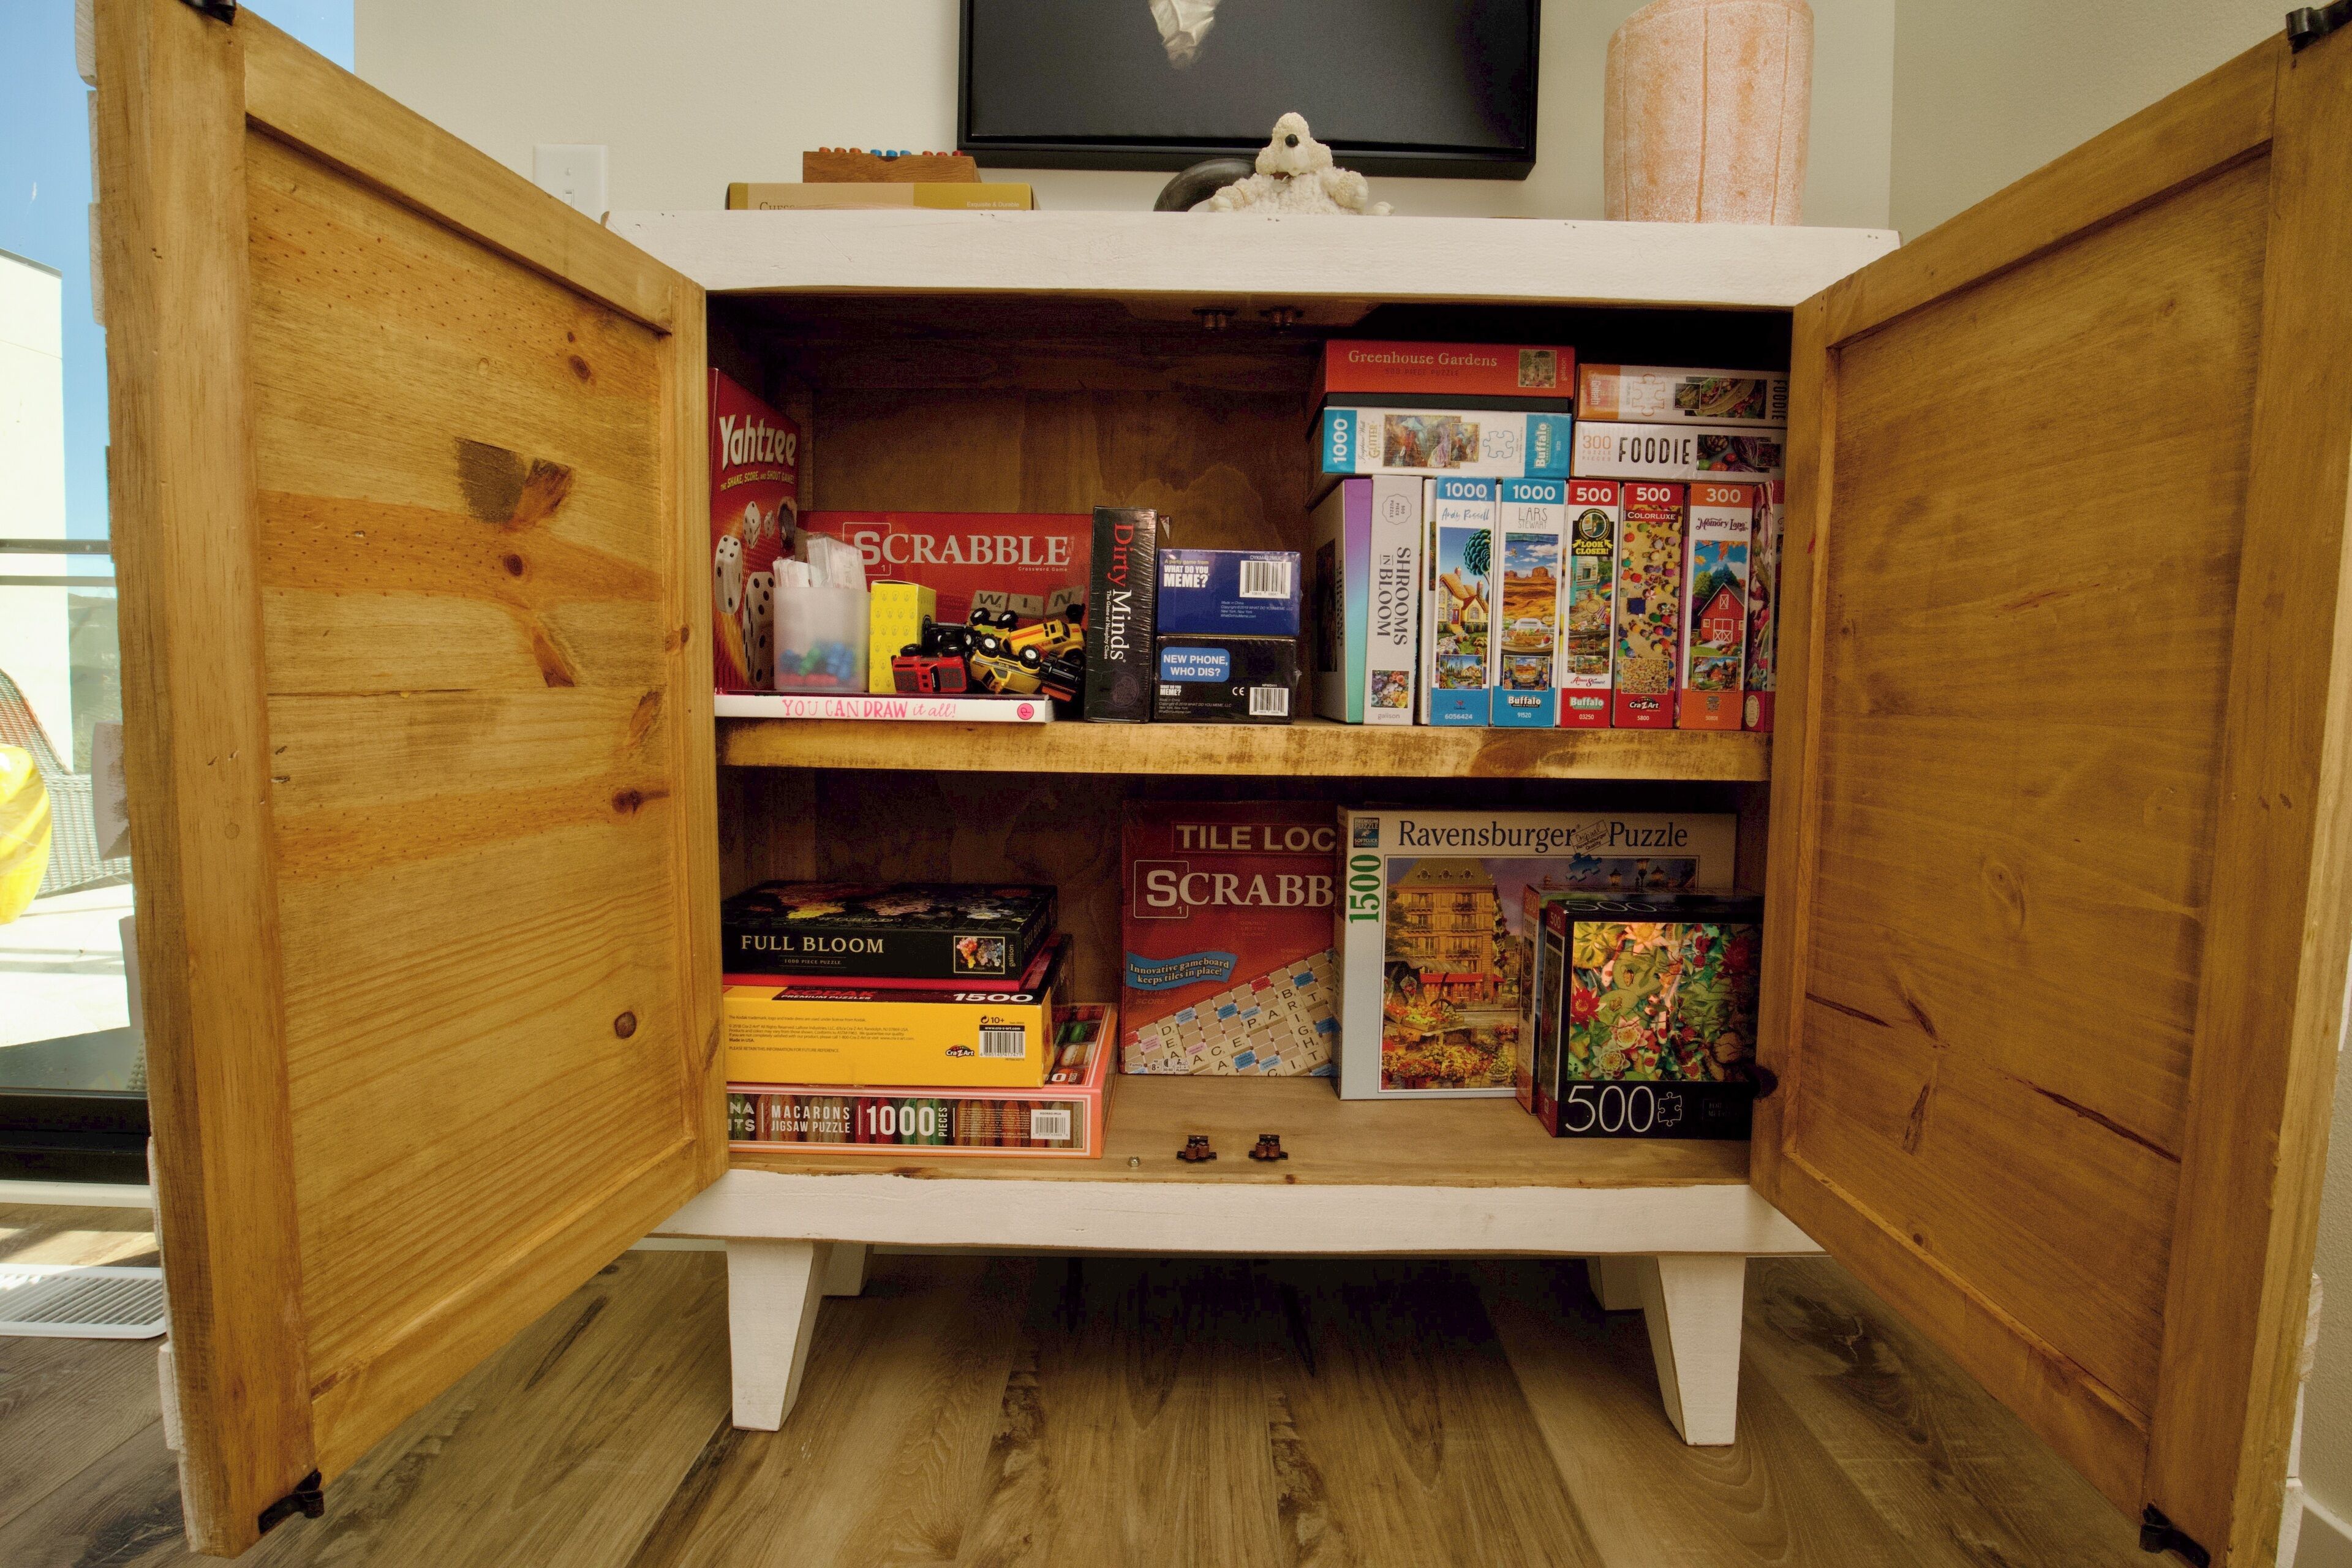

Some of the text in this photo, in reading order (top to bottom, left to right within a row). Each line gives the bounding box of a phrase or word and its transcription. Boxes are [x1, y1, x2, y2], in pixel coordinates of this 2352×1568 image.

[1348, 350, 1498, 366] Greenhouse Gardens
[1771, 380, 1788, 420] FOODIE
[718, 414, 796, 472] Yahtzee
[1332, 418, 1348, 464] 1000
[1535, 423, 1547, 467] Buffalo
[1582, 435, 1612, 450] 300
[1618, 437, 1691, 465] FOODIE
[1445, 482, 1487, 499] 1000
[1512, 484, 1556, 500] 1000
[1576, 487, 1612, 502] 500
[1636, 487, 1671, 502] 500
[1706, 488, 1741, 503] 300
[1518, 507, 1548, 522] LARS
[1627, 511, 1676, 520] COLORLUXE
[1518, 521, 1548, 529] STEWART
[1695, 518, 1747, 532] Memory Lane
[854, 530, 1070, 566] SCRABBLE
[1107, 523, 1134, 587] Dirty
[1164, 565, 1184, 573] WHAT
[1164, 573, 1208, 588] MEME?
[1377, 555, 1393, 636] IN BLOOM
[1393, 546, 1412, 646] SHROOMS
[1110, 589, 1132, 660] Minds
[1163, 654, 1228, 666] NEW PHONE,
[1170, 667, 1221, 676] WHO DIS?
[782, 699, 956, 718] YOU CAN DRAW it all!
[1508, 696, 1541, 705] Buffalo
[1570, 697, 1604, 706] Buffalo
[1176, 824, 1336, 851] TILE LOC
[1398, 820, 1688, 853] Ravensburger Puzzle
[1146, 869, 1335, 908] SCRABB
[1349, 854, 1381, 924] 1500
[1565, 900, 1657, 912] 500
[741, 935, 884, 954] FULL BLOOM
[1129, 957, 1230, 975] Innovative gameboard
[1137, 967, 1223, 986] keeps tiles in place!
[953, 993, 1034, 1003] 1500
[771, 1104, 850, 1120] MACARONS
[1565, 1085, 1654, 1133] 500
[771, 1119, 851, 1134] JIGSAW PUZZLE
[866, 1106, 935, 1136] 1000
[938, 1106, 948, 1137] PIECES
